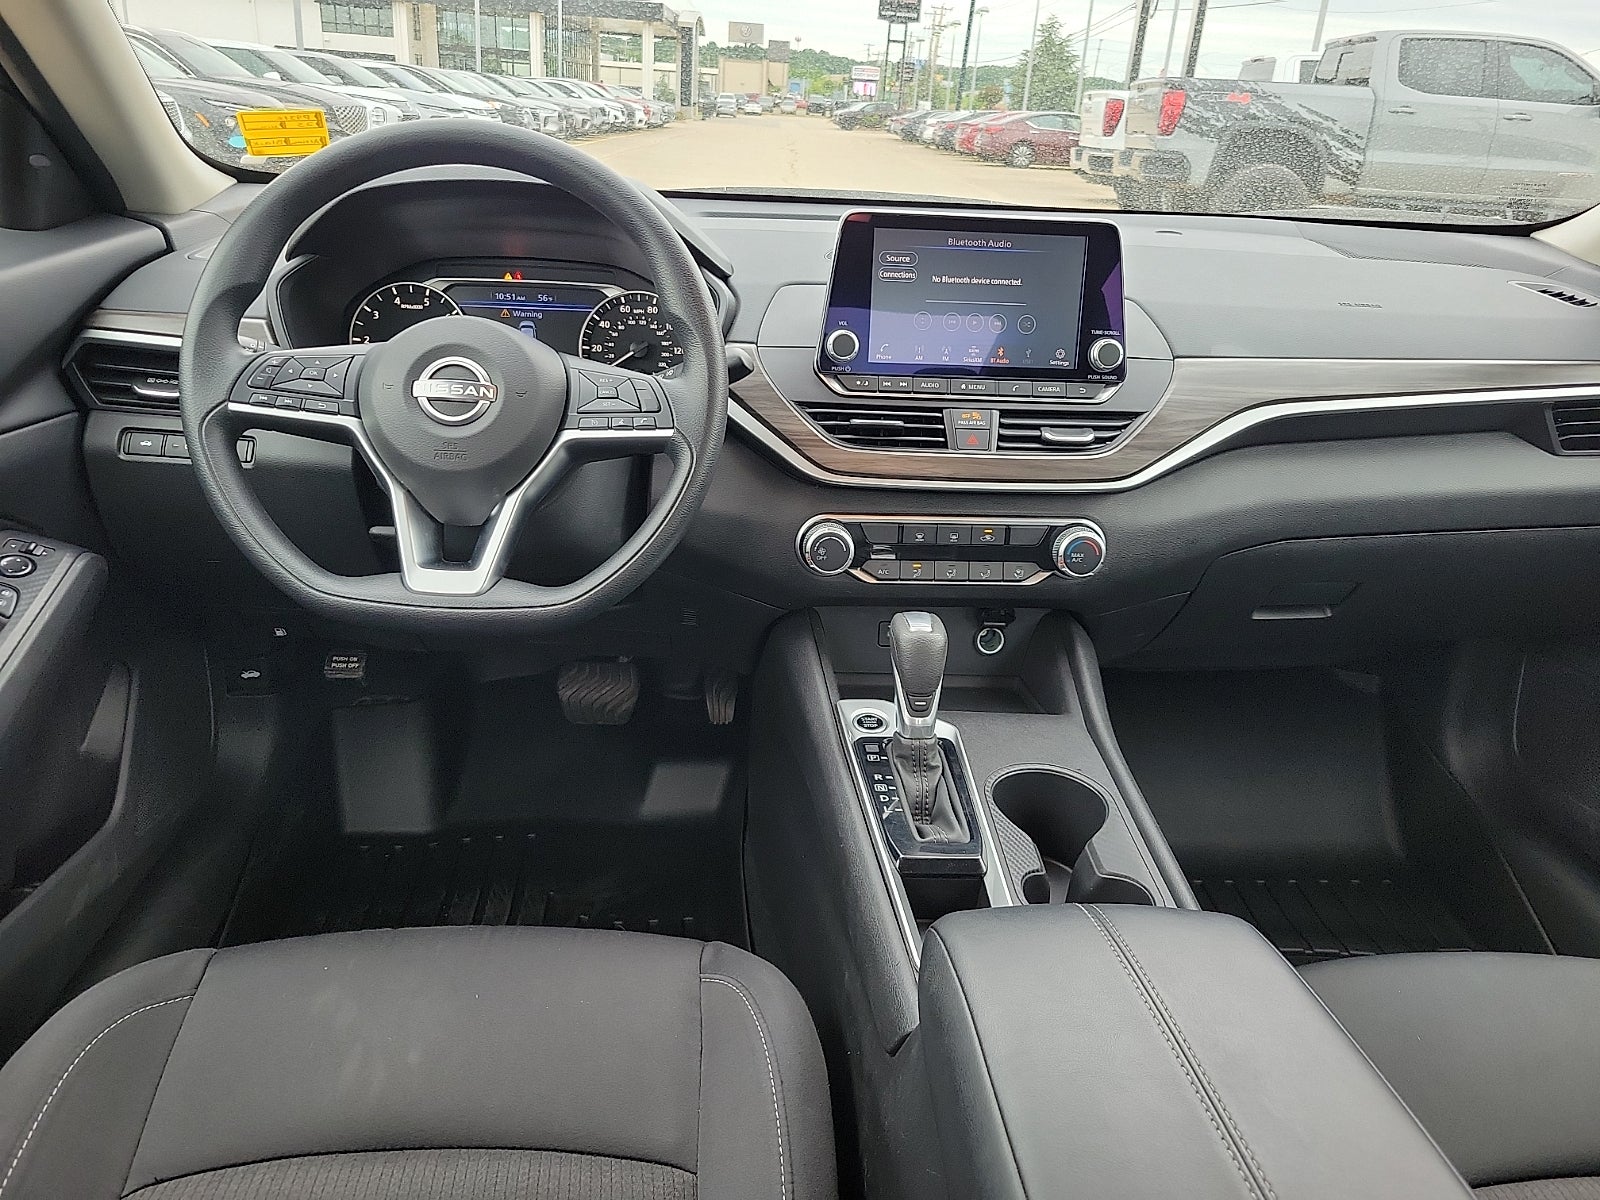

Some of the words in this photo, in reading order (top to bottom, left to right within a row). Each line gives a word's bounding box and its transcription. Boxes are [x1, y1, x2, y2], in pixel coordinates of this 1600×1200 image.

[948, 238, 986, 247] Bluetooth
[988, 240, 1012, 248] Audio
[886, 254, 911, 262] Source
[880, 270, 916, 280] Connections
[932, 275, 940, 283] No
[942, 276, 970, 284] Bluetooth
[970, 276, 990, 284] device
[990, 278, 1023, 286] connected.
[394, 296, 400, 306] 4
[495, 292, 516, 300] 10:51
[424, 298, 430, 306] 5
[373, 310, 380, 320] 3
[512, 310, 543, 319] Warning
[414, 384, 494, 398] NISSAN
[434, 452, 468, 461] AIRBAG
